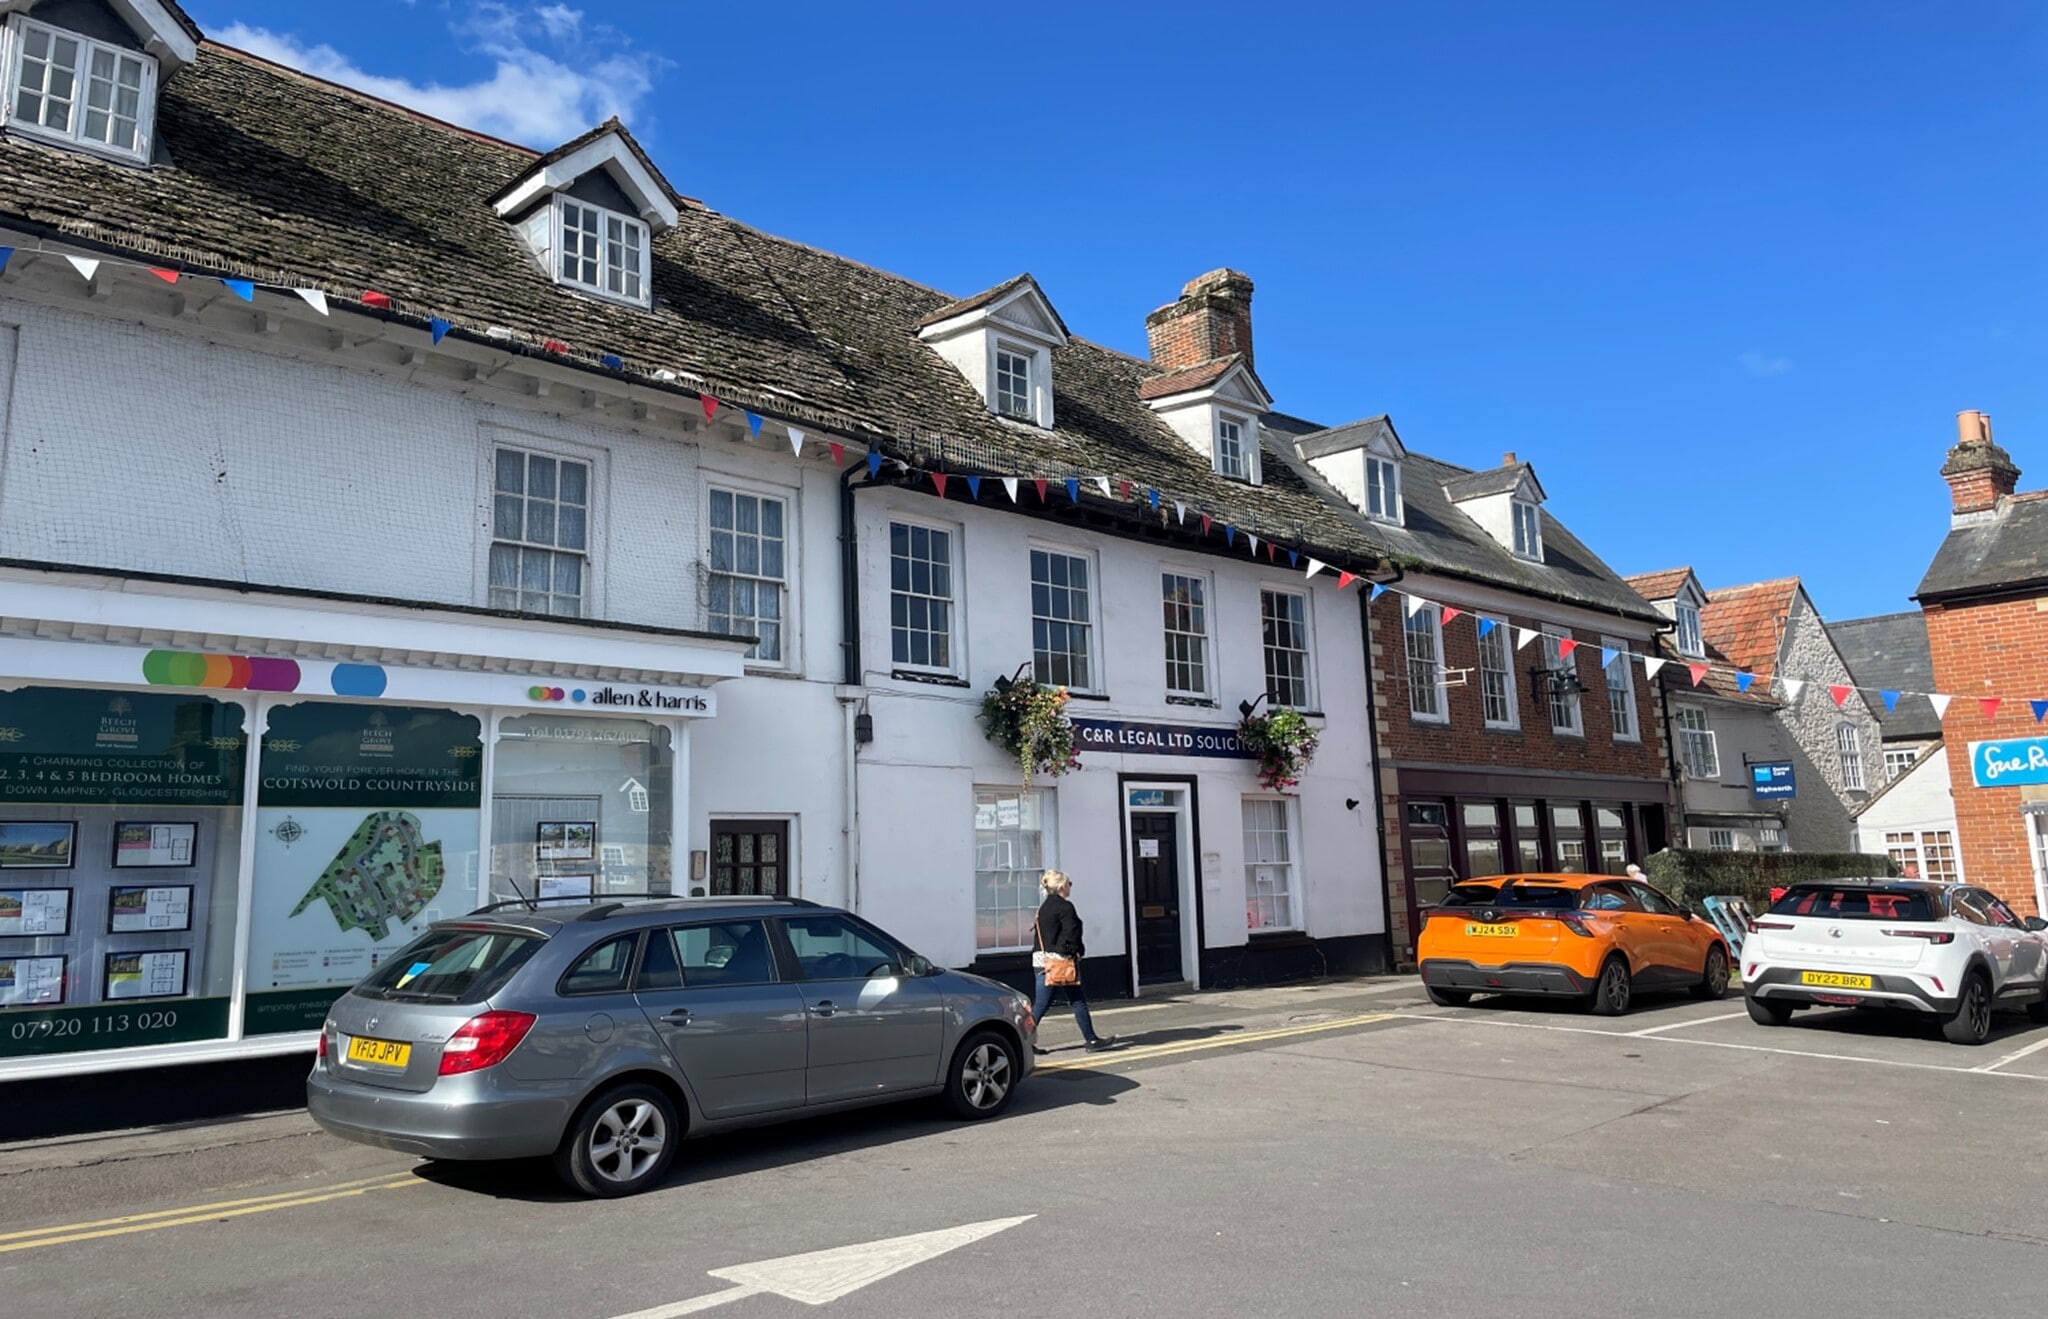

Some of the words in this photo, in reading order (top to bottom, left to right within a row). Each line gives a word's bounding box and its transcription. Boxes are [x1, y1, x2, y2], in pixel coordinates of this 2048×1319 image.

[592, 687, 634, 706] allen
[638, 689, 653, 707] &
[656, 691, 707, 711] harris
[101, 717, 136, 726] BEECH
[1082, 727, 1115, 743] C&R
[1119, 729, 1165, 746] LEGAL
[1168, 733, 1193, 748] LTD
[19, 756, 28, 765] A
[33, 756, 103, 767] CHARMING
[107, 758, 185, 770] COLLECTION
[190, 761, 205, 770] OF
[285, 764, 310, 773] FIND
[314, 765, 343, 774] YOUR
[347, 766, 392, 775] FOREVER
[396, 767, 425, 776] HOME
[429, 768, 439, 776] IN
[443, 768, 460, 776] THE
[1984, 746, 2028, 779] Sue
[35, 771, 44, 781] 4
[50, 771, 61, 781] &
[67, 771, 75, 781] 5
[81, 772, 162, 783] BEDROOM
[168, 773, 222, 784] HOMES
[263, 777, 360, 791] COTSWOLD
[366, 779, 477, 792] COUNTRYSIDE
[5, 785, 47, 795] DOWN
[112, 787, 230, 799] GLOUCESTERSHIRE
[1807, 972, 1839, 984] DY22
[1841, 975, 1867, 987] BRX
[11, 1018, 81, 1040] 07920
[91, 1014, 129, 1033] 113
[137, 1010, 177, 1030] 020
[355, 1038, 377, 1058] YF13
[378, 1041, 402, 1061] JPV
